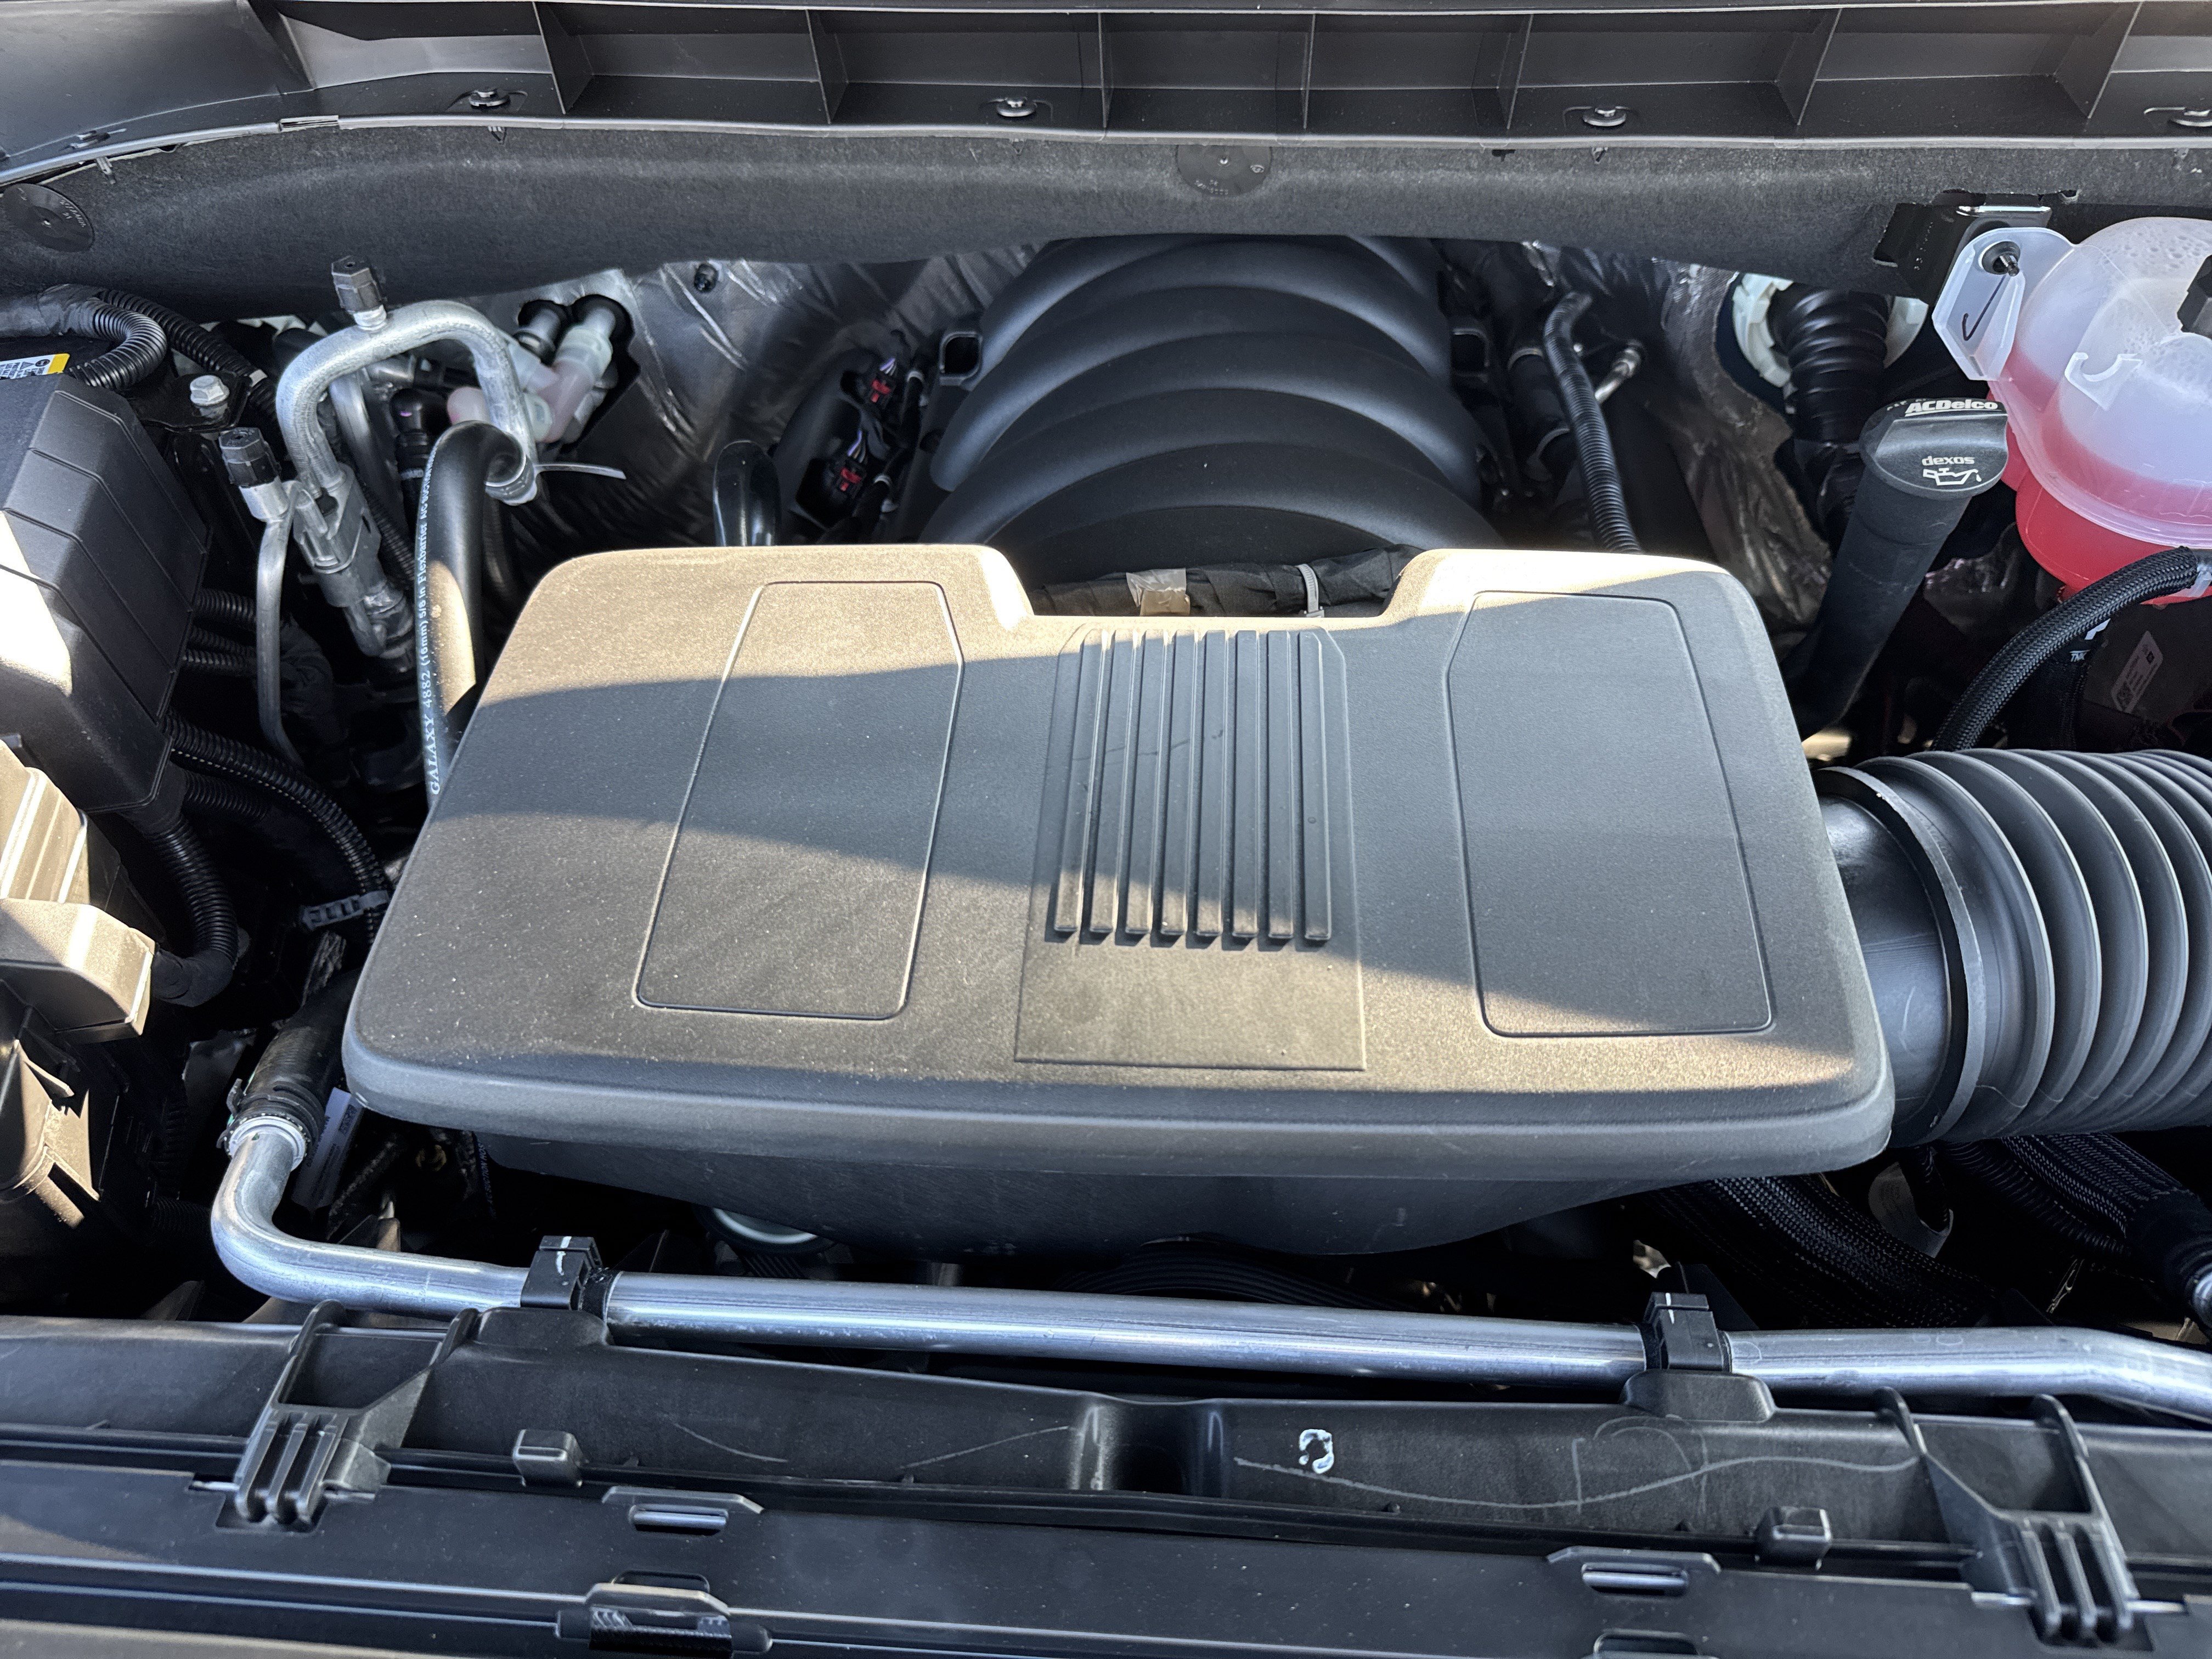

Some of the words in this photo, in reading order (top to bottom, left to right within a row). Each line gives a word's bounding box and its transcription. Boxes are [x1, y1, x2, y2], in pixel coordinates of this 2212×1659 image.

[1905, 399, 1998, 414] ACDelco
[1922, 455, 1975, 466] dexos
[417, 523, 427, 584] Flexbarrier
[418, 600, 427, 619] 5/8
[419, 620, 431, 665] (16mm)
[421, 670, 432, 708] 4882
[424, 713, 441, 794] GALAXY
